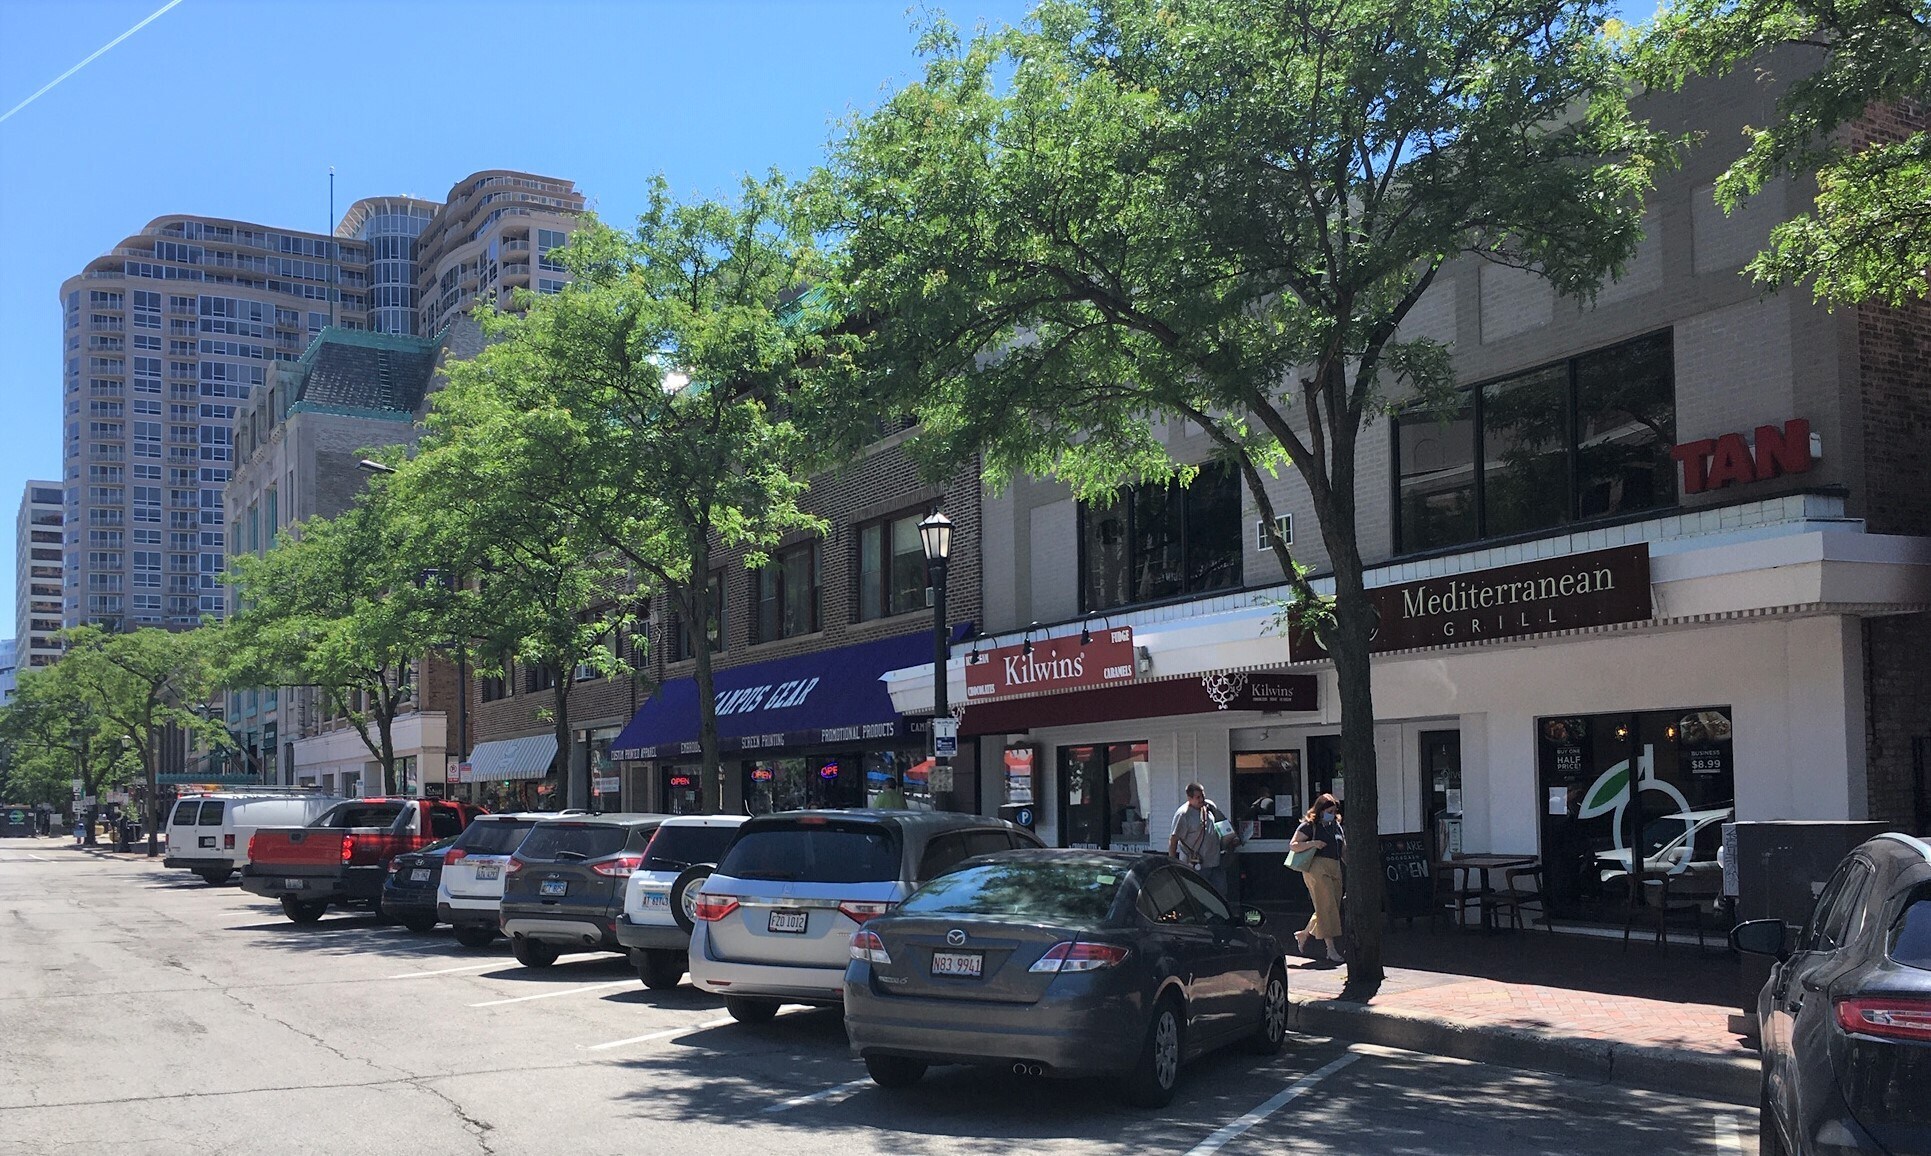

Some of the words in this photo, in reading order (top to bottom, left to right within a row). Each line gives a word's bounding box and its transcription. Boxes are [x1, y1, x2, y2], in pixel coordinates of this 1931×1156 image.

[1670, 418, 1810, 494] TAN
[1401, 565, 1615, 620] Mediterranean
[1443, 608, 1558, 637] GRILL
[1110, 630, 1130, 644] FUDGE
[1003, 650, 1083, 686] Kilwins
[1103, 665, 1132, 680] CARAMELS
[714, 684, 773, 716] CAMPUS
[763, 676, 820, 711] GEAR
[1251, 683, 1294, 697] Kilwins
[821, 726, 861, 743] PROMOTIONAL
[862, 722, 895, 739] PRODUCTS
[741, 734, 761, 749] SCREEN
[761, 733, 785, 748] PRINTING
[610, 749, 625, 761] CUSTOM
[624, 748, 640, 760] PRINTED
[640, 746, 657, 759] APPAREL
[1557, 756, 1581, 764] HALF
[1691, 760, 1721, 769] $8.99
[670, 777, 690, 786] OPEN
[752, 770, 772, 780] OPEN
[786, 916, 805, 928] 1012
[933, 957, 952, 972] N83
[957, 958, 981, 973] 9941
